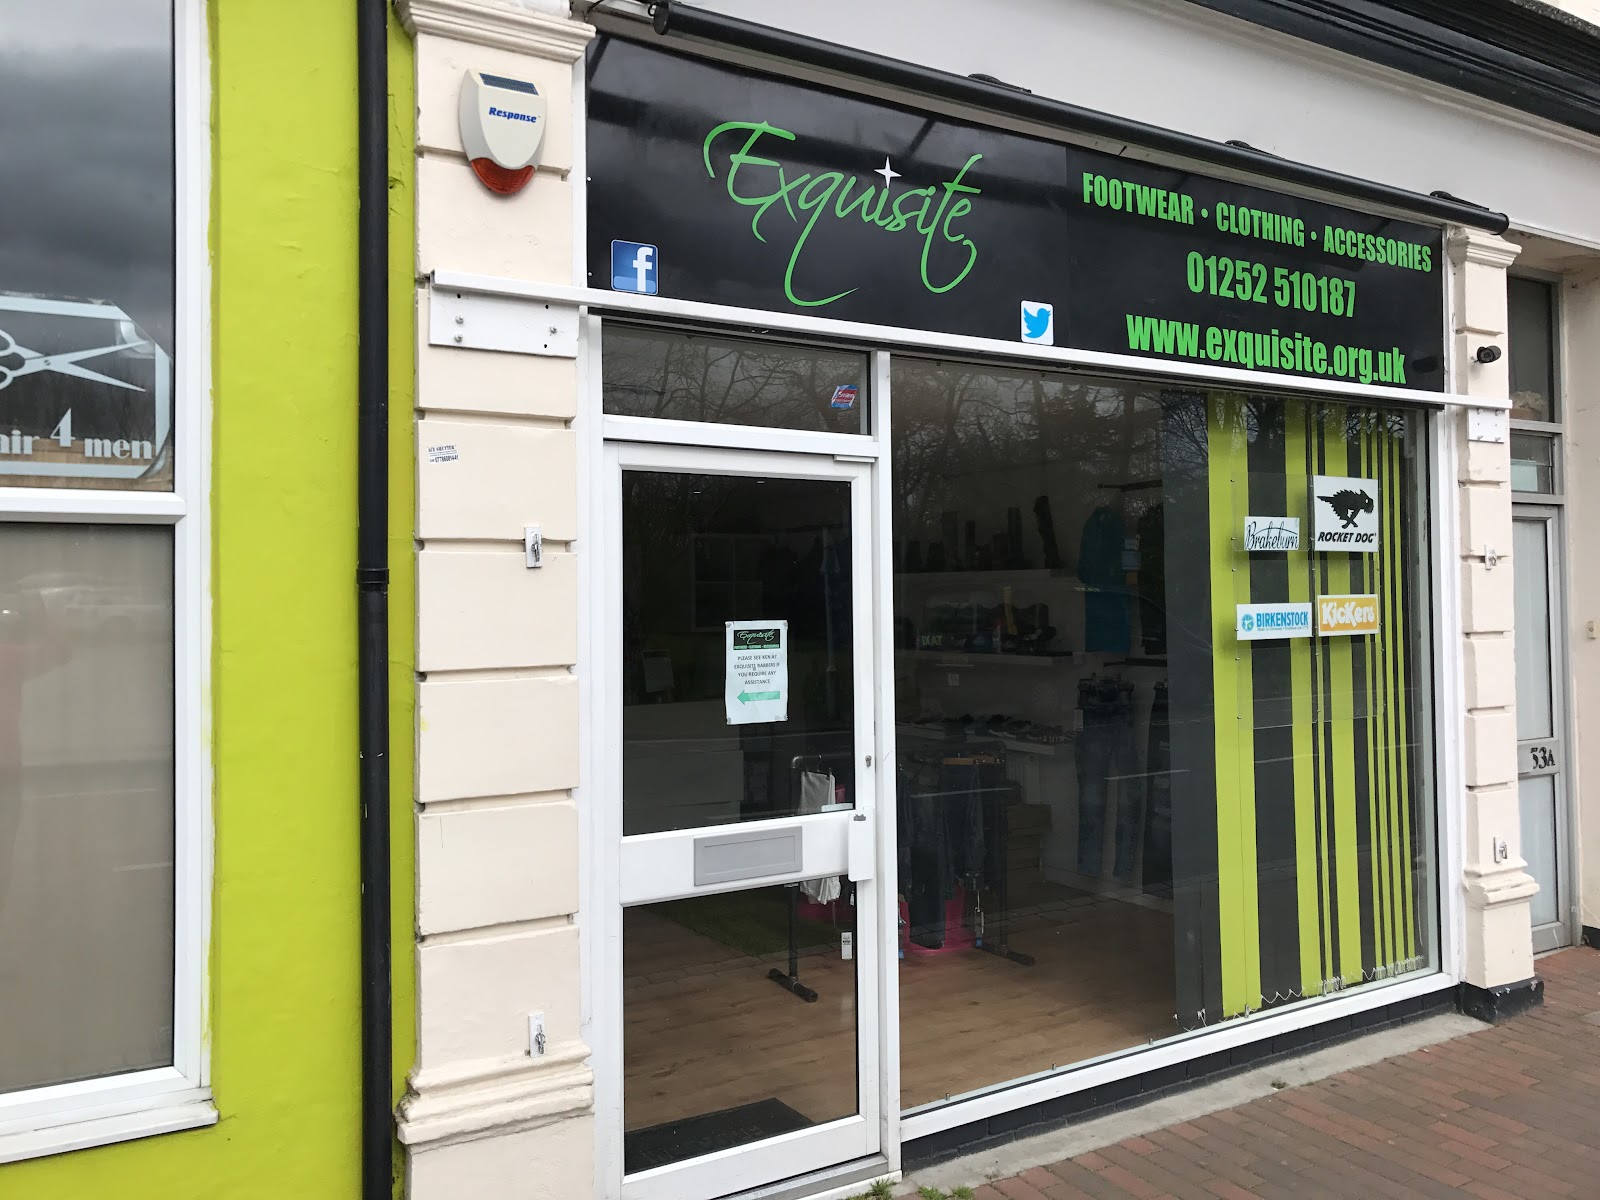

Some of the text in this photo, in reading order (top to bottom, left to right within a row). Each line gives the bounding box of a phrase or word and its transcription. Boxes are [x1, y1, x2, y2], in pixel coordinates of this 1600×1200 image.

[489, 107, 537, 123] Response
[703, 121, 983, 307] Exquisite
[1083, 172, 1432, 273] FOOTWEAR CLOTHING ACCESSORIES
[1186, 251, 1356, 318] 01252 510187
[1125, 313, 1407, 385] www.exquisite.org.uk
[50, 407, 76, 448] 4
[84, 437, 152, 459] men
[1317, 531, 1375, 544] ROCKET DOG
[1256, 611, 1309, 628] BIRKENSTOCK
[1530, 746, 1556, 769] 53A
